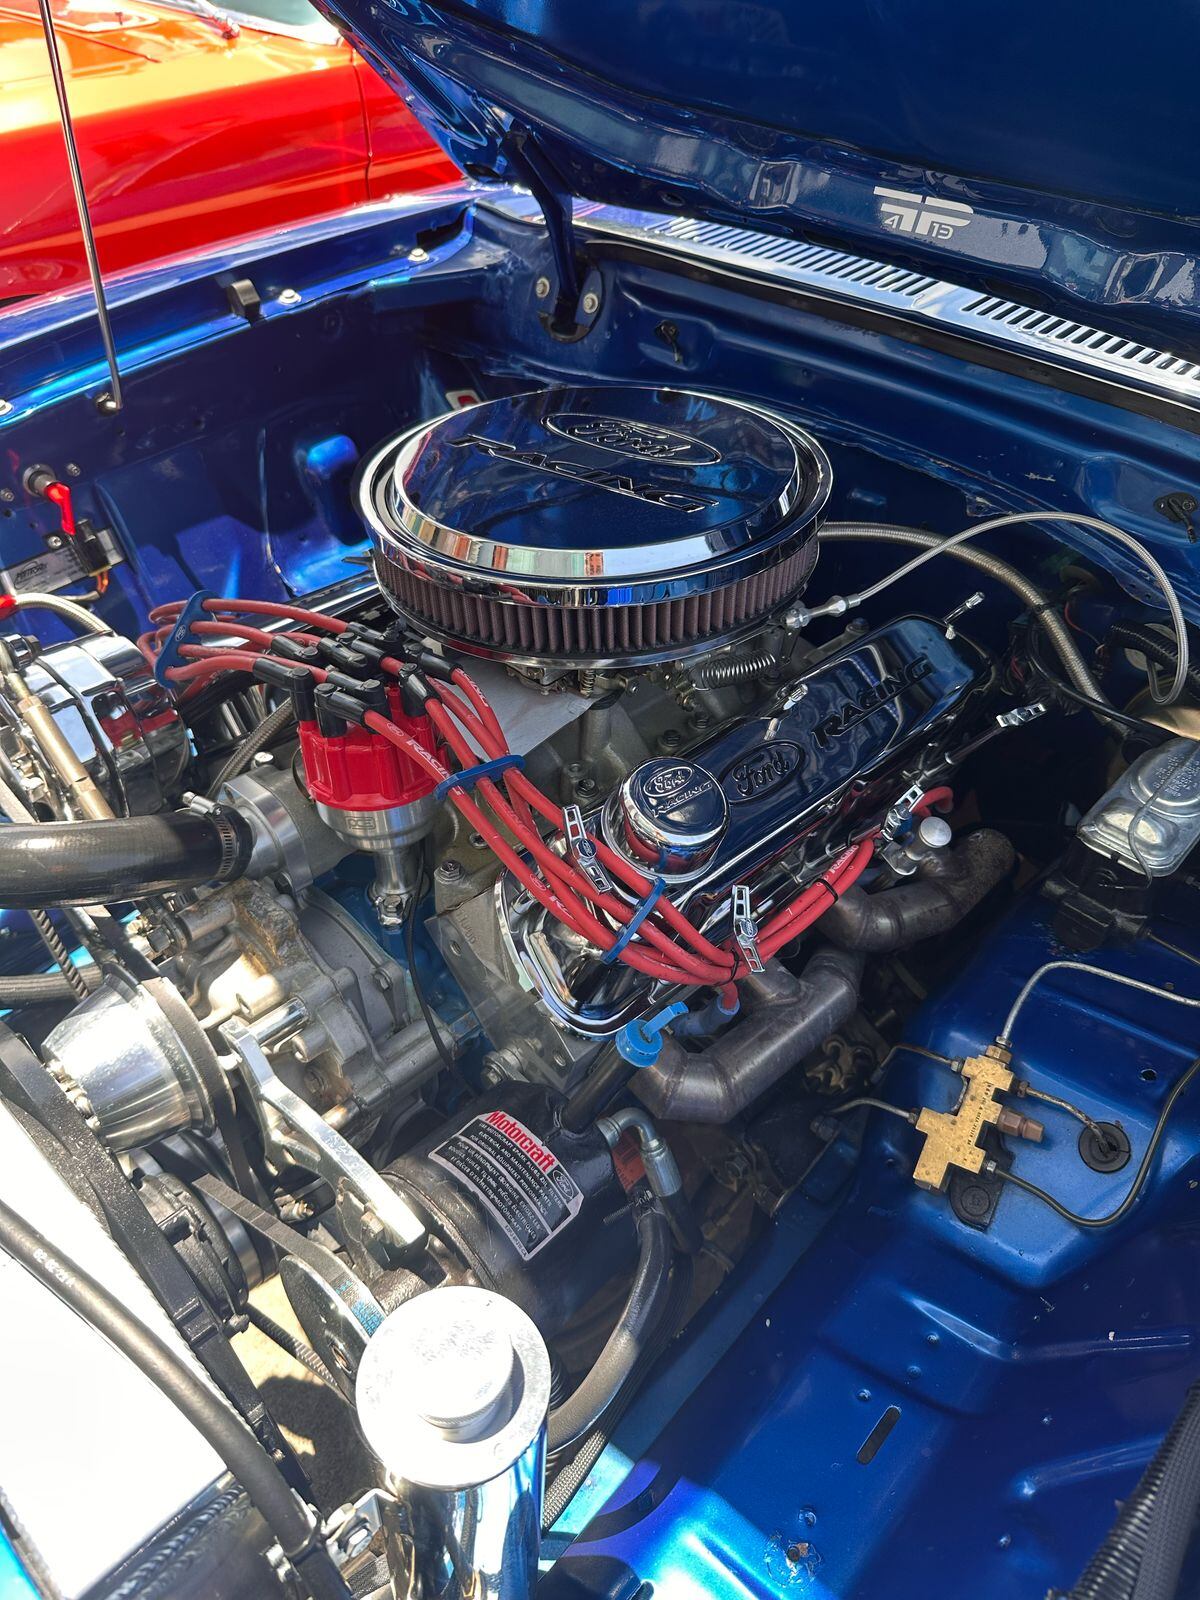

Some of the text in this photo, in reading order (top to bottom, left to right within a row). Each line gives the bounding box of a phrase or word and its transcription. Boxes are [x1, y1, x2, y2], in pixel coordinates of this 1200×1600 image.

[566, 420, 692, 458] Ford
[447, 433, 720, 513] RACING
[811, 654, 935, 749] RACING
[653, 770, 685, 793] Ford
[732, 749, 790, 797] Ford
[829, 844, 860, 875] RACING
[469, 1134, 479, 1142] FOR
[476, 1139, 497, 1156] ORIGINAL
[495, 1153, 521, 1180] EQUIPMENT
[485, 1110, 556, 1173] Motorcraft
[511, 1146, 528, 1162] SPARK
[477, 1130, 553, 1207] ELECTRICAL AND MAINTENANCE PARTS
[557, 1176, 570, 1194] Ford
[518, 1200, 534, 1220] EXIGEZ
